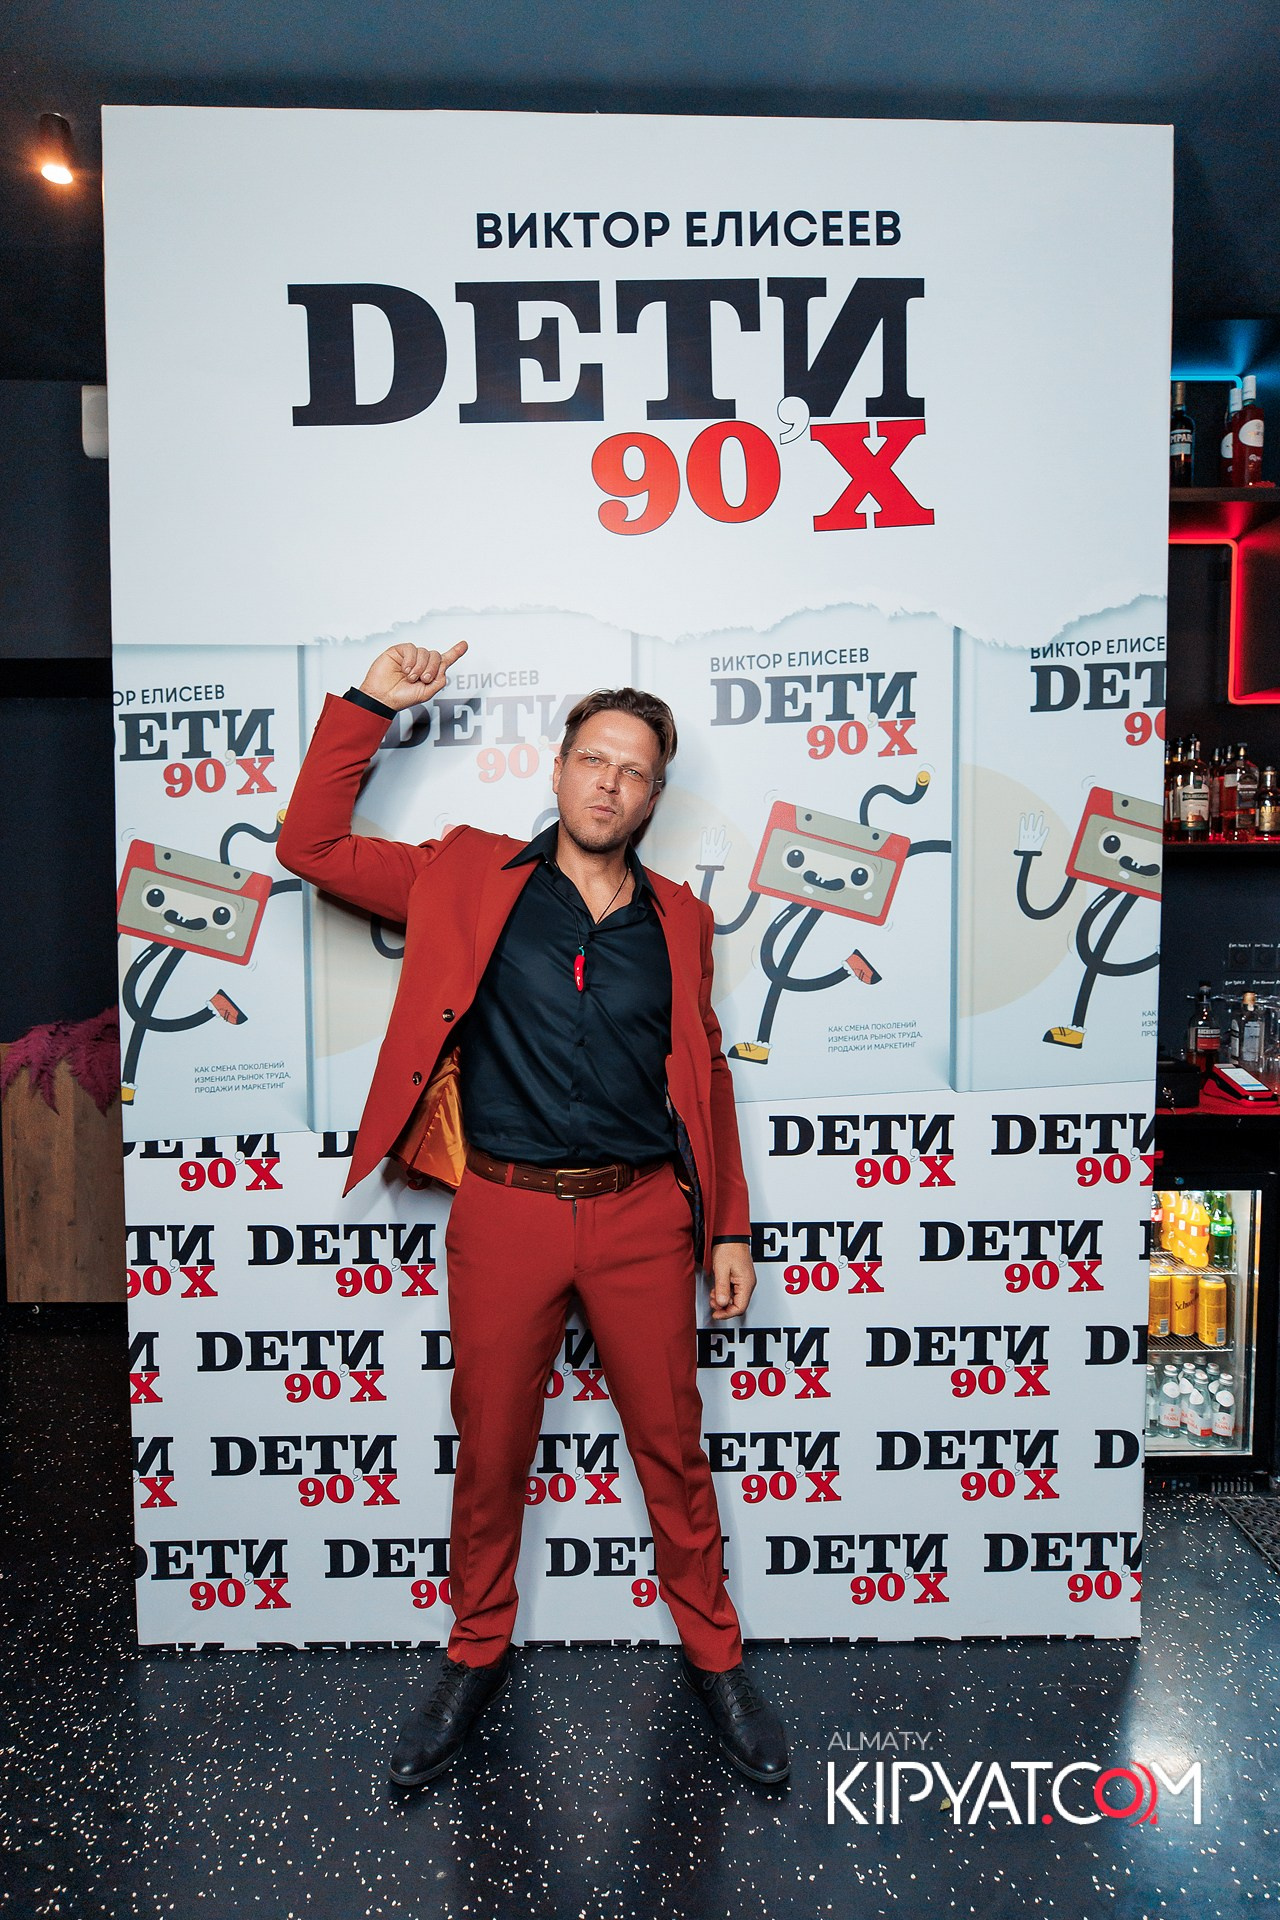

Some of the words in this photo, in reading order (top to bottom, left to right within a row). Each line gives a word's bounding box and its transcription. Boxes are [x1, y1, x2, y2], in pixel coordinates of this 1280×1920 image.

[477, 212, 669, 249] ВИКТОР
[687, 210, 902, 247] ЕЛИСЕЕВ
[1030, 640, 1102, 659] ВИКТОР
[710, 653, 783, 672] ВИКТОР
[787, 647, 870, 667] ЕЛИСЕЕВ
[456, 670, 540, 690] ЕЛИСЕЕВ
[141, 684, 225, 704] ЕЛИСЕЕВ
[828, 1025, 843, 1033] КАК
[844, 1023, 870, 1032] СМЕНА
[871, 1020, 917, 1030] ПОКОЛЕНИЙ
[828, 1034, 869, 1043] ИЗМЕНИЛА
[870, 1032, 897, 1041] РЫНОК
[898, 1031, 923, 1039] ТРУДА,
[828, 1044, 866, 1053] ПРОДАЖИ
[873, 1041, 917, 1050] МАРКЕТИНГ
[210, 1064, 237, 1073] СМЕНА
[238, 1061, 285, 1071] ПОКОЛЕНИЙ
[194, 1075, 236, 1084] ИЗМЕНИЛА
[237, 1073, 264, 1082] РЫНОК
[266, 1071, 292, 1080] ТРУДА,
[194, 1085, 234, 1094] ПРОДАЖИ
[234, 1084, 241, 1092] И
[241, 1081, 286, 1091] МАРКЕТИНГ
